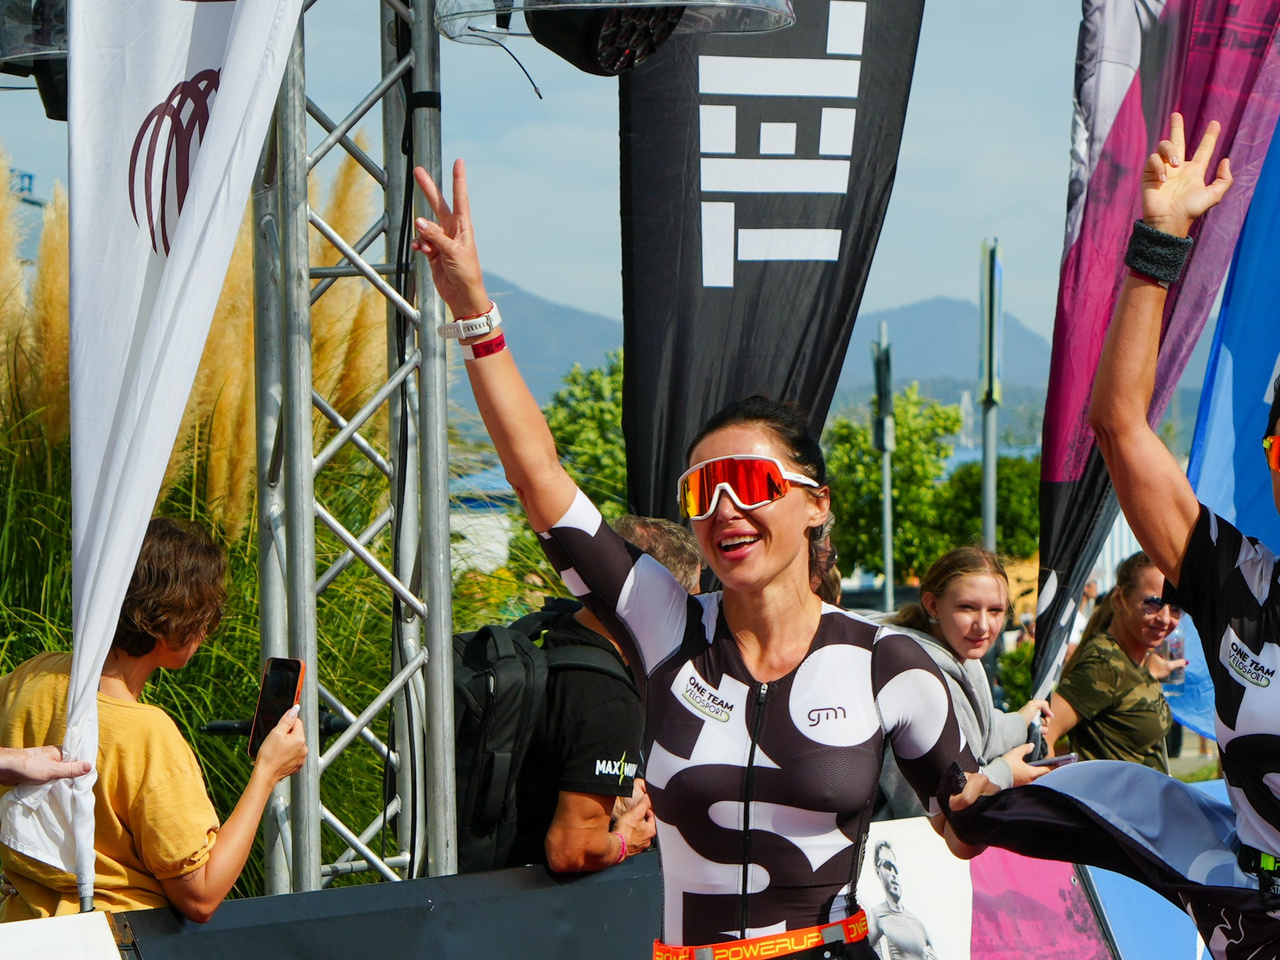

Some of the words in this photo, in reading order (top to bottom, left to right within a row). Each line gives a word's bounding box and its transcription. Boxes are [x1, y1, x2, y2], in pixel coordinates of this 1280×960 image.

[1231, 641, 1250, 663] ONE
[1250, 659, 1276, 678] TEAM
[685, 684, 725, 718] VELOSPORT
[689, 676, 709, 697] ONE
[707, 692, 734, 712] TEAM
